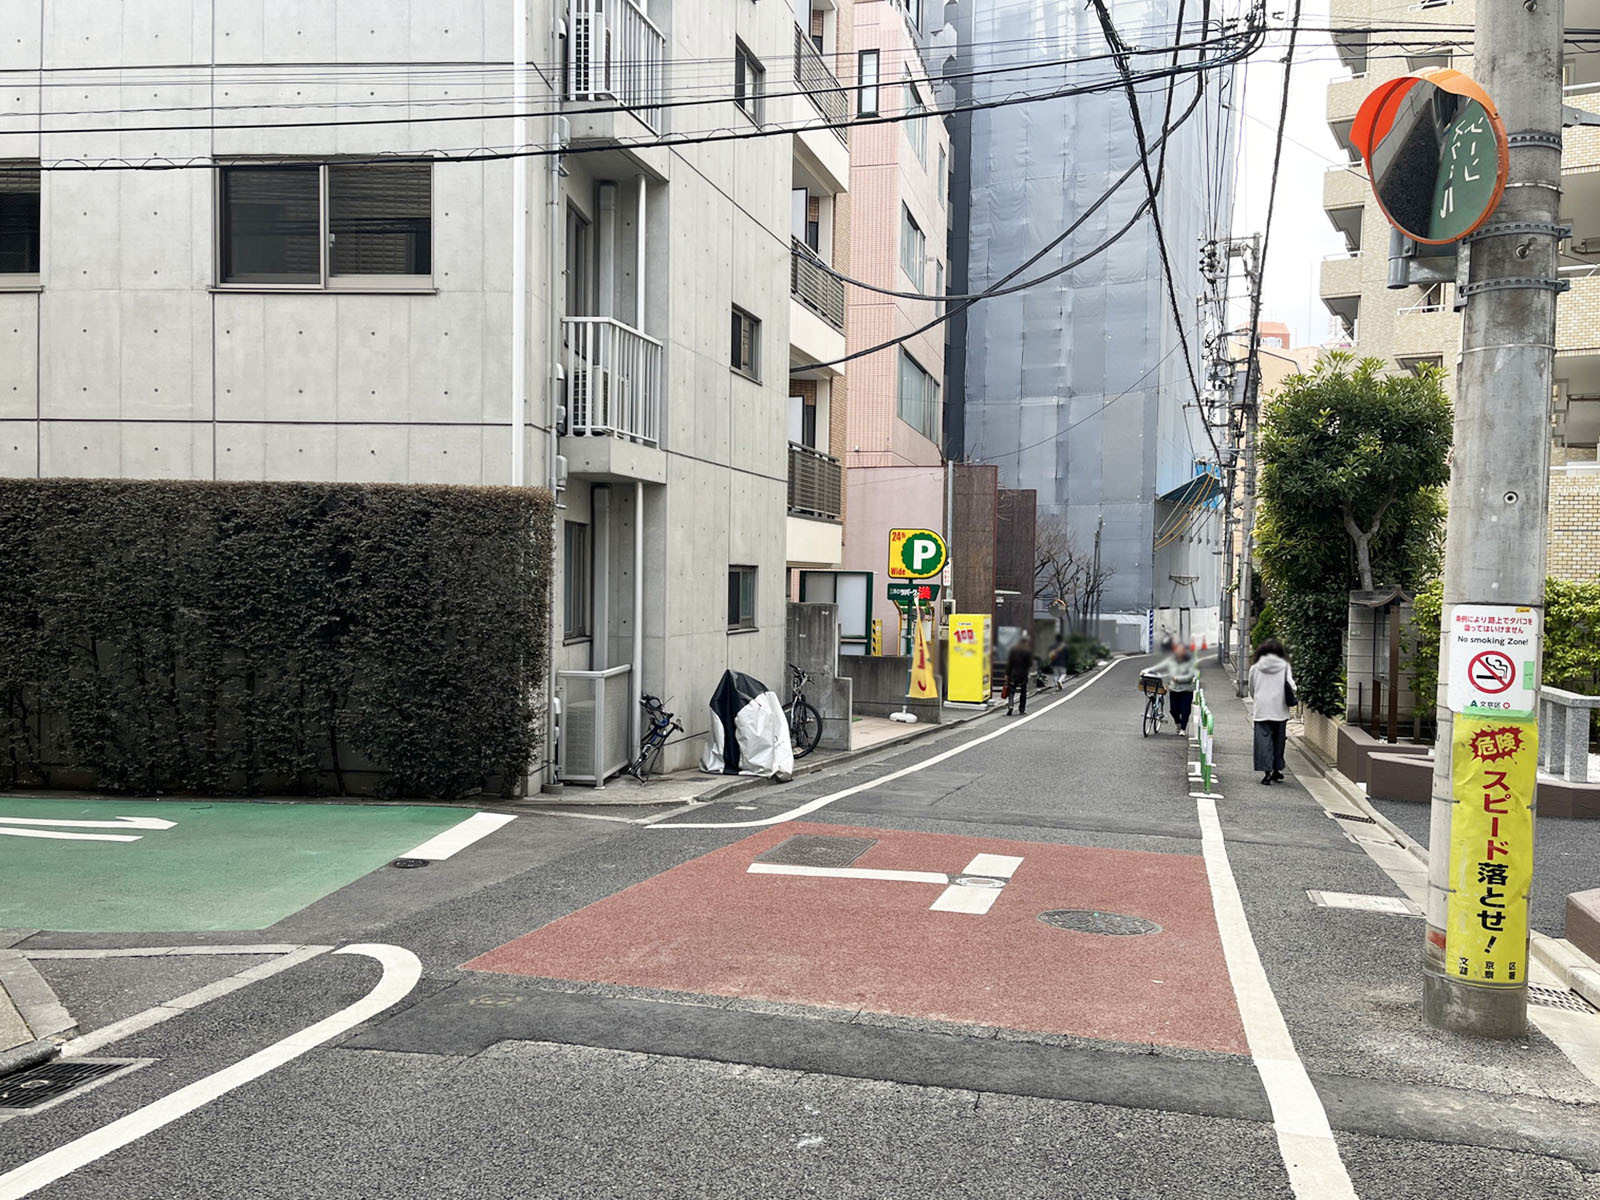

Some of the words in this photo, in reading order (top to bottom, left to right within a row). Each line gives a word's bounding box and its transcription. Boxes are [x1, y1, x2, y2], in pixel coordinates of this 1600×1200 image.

[913, 539, 937, 570] P
[1458, 635, 1468, 643] No
[1470, 636, 1505, 646] smoking
[1507, 637, 1529, 645] Zone!
[1464, 624, 1524, 634] 吸ってはいけません
[1475, 732, 1518, 756] 危険
[1477, 770, 1511, 954] スピード落とせ！
